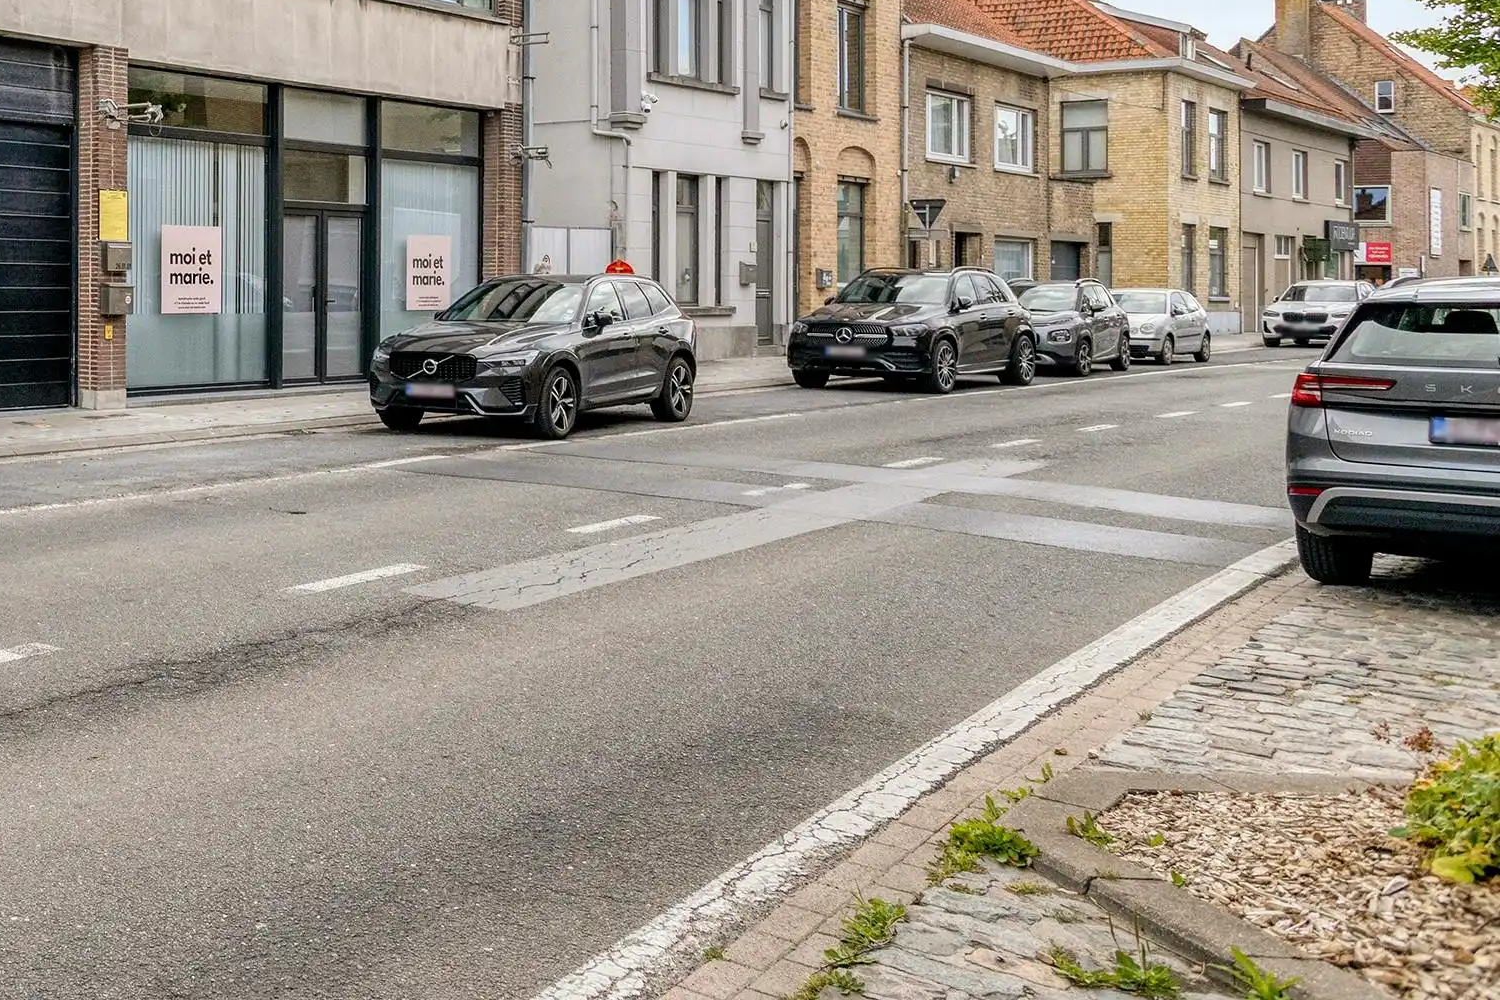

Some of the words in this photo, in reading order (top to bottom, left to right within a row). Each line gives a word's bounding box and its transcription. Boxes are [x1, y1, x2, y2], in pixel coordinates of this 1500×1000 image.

[169, 247, 196, 265] moi
[198, 249, 212, 265] et
[412, 253, 432, 269] moi
[433, 255, 444, 269] et
[169, 266, 214, 285] marie.
[412, 270, 445, 286] marie.
[1425, 383, 1500, 394] SK
